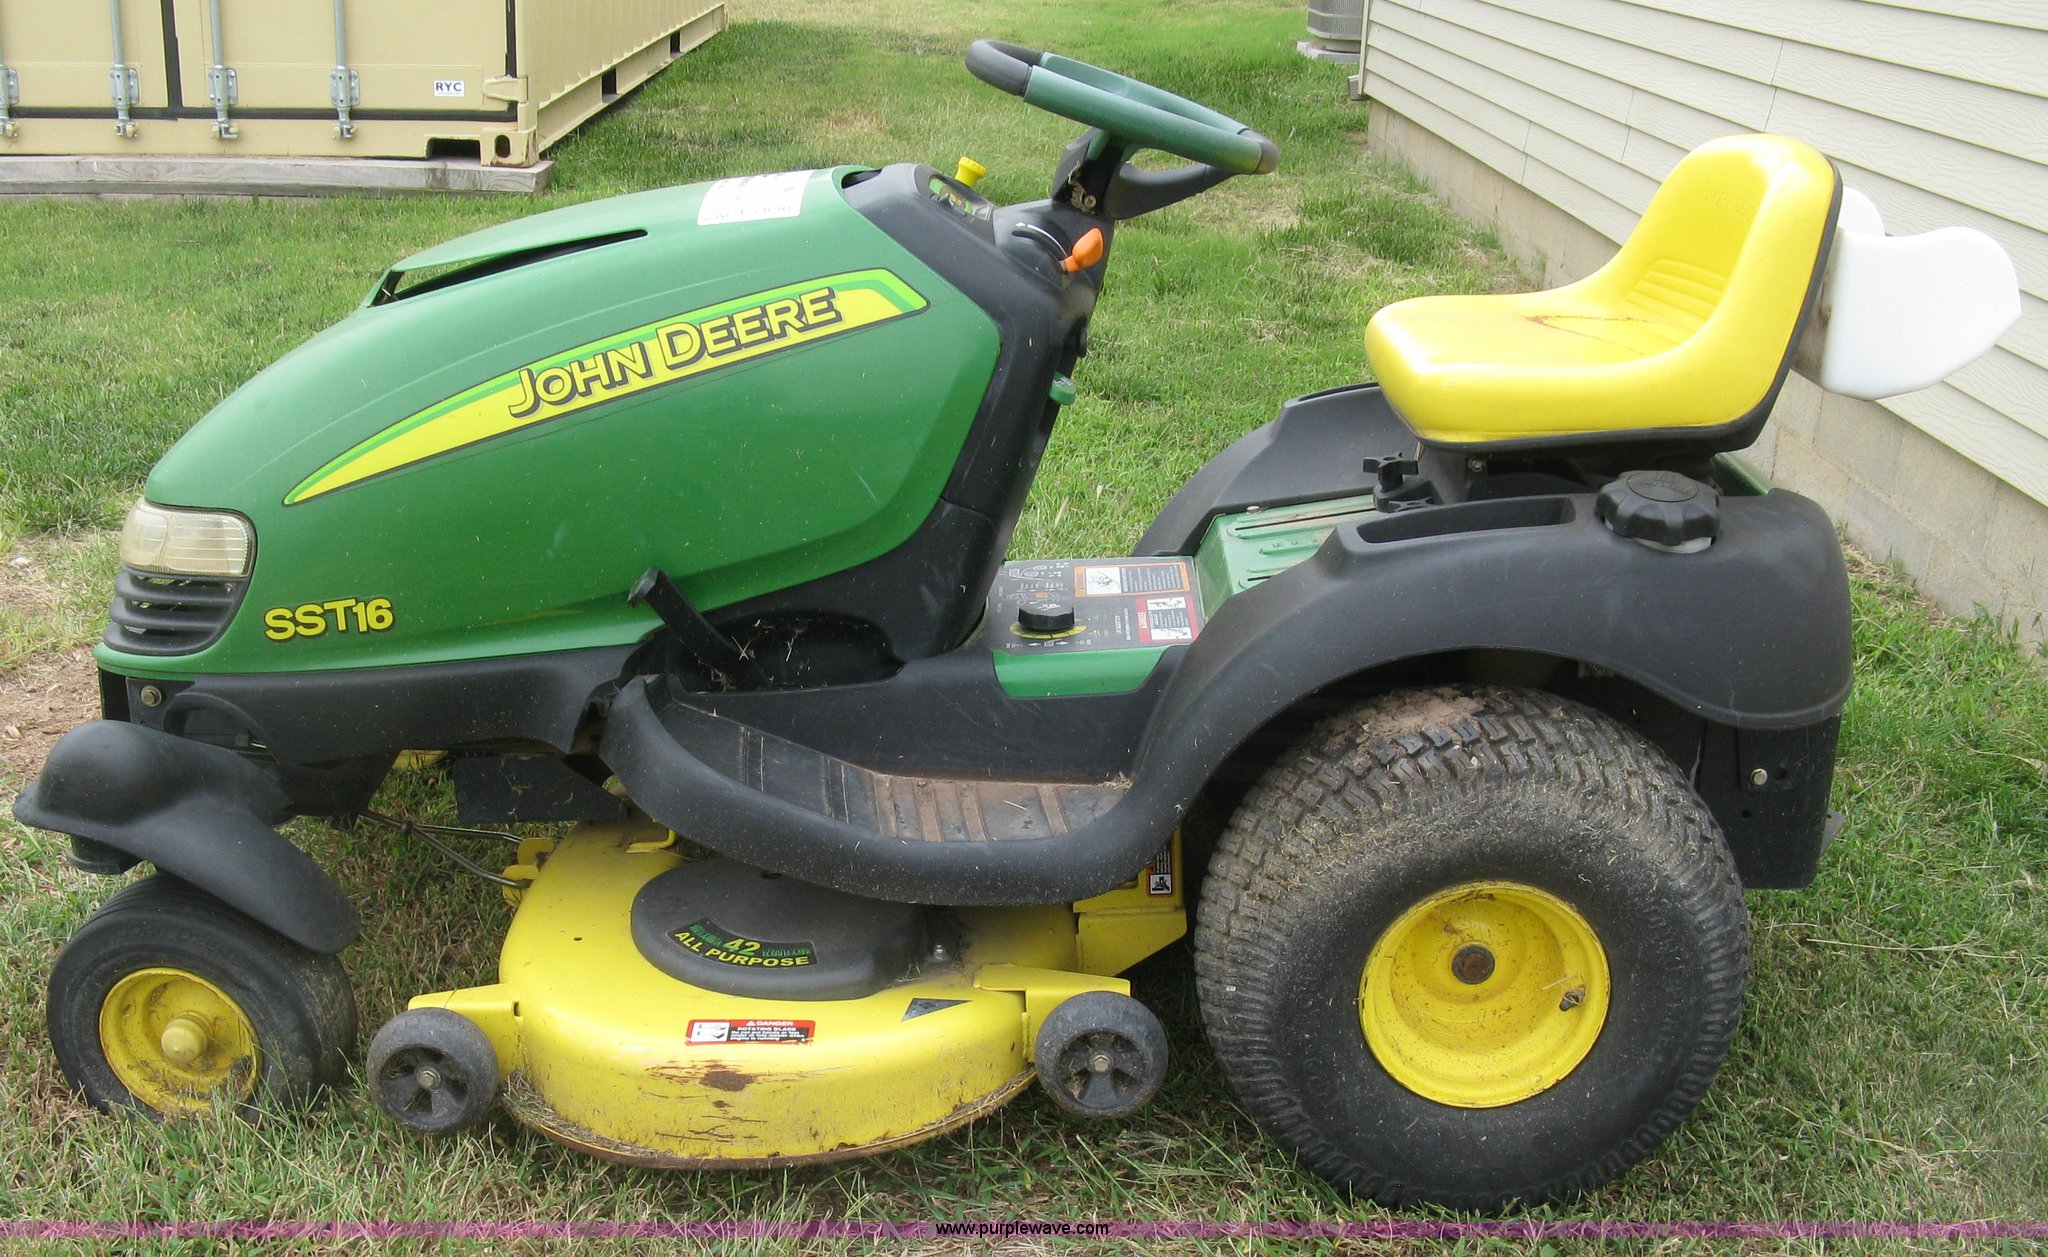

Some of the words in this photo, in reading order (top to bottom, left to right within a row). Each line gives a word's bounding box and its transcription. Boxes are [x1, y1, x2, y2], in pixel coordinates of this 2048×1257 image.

[435, 82, 462, 92] RYC
[508, 341, 653, 418] JOHN
[655, 287, 842, 371] DEERE
[264, 597, 395, 642] SST16
[674, 931, 701, 953] ALL
[704, 947, 810, 967] PURPOSE
[722, 938, 762, 957] 42
